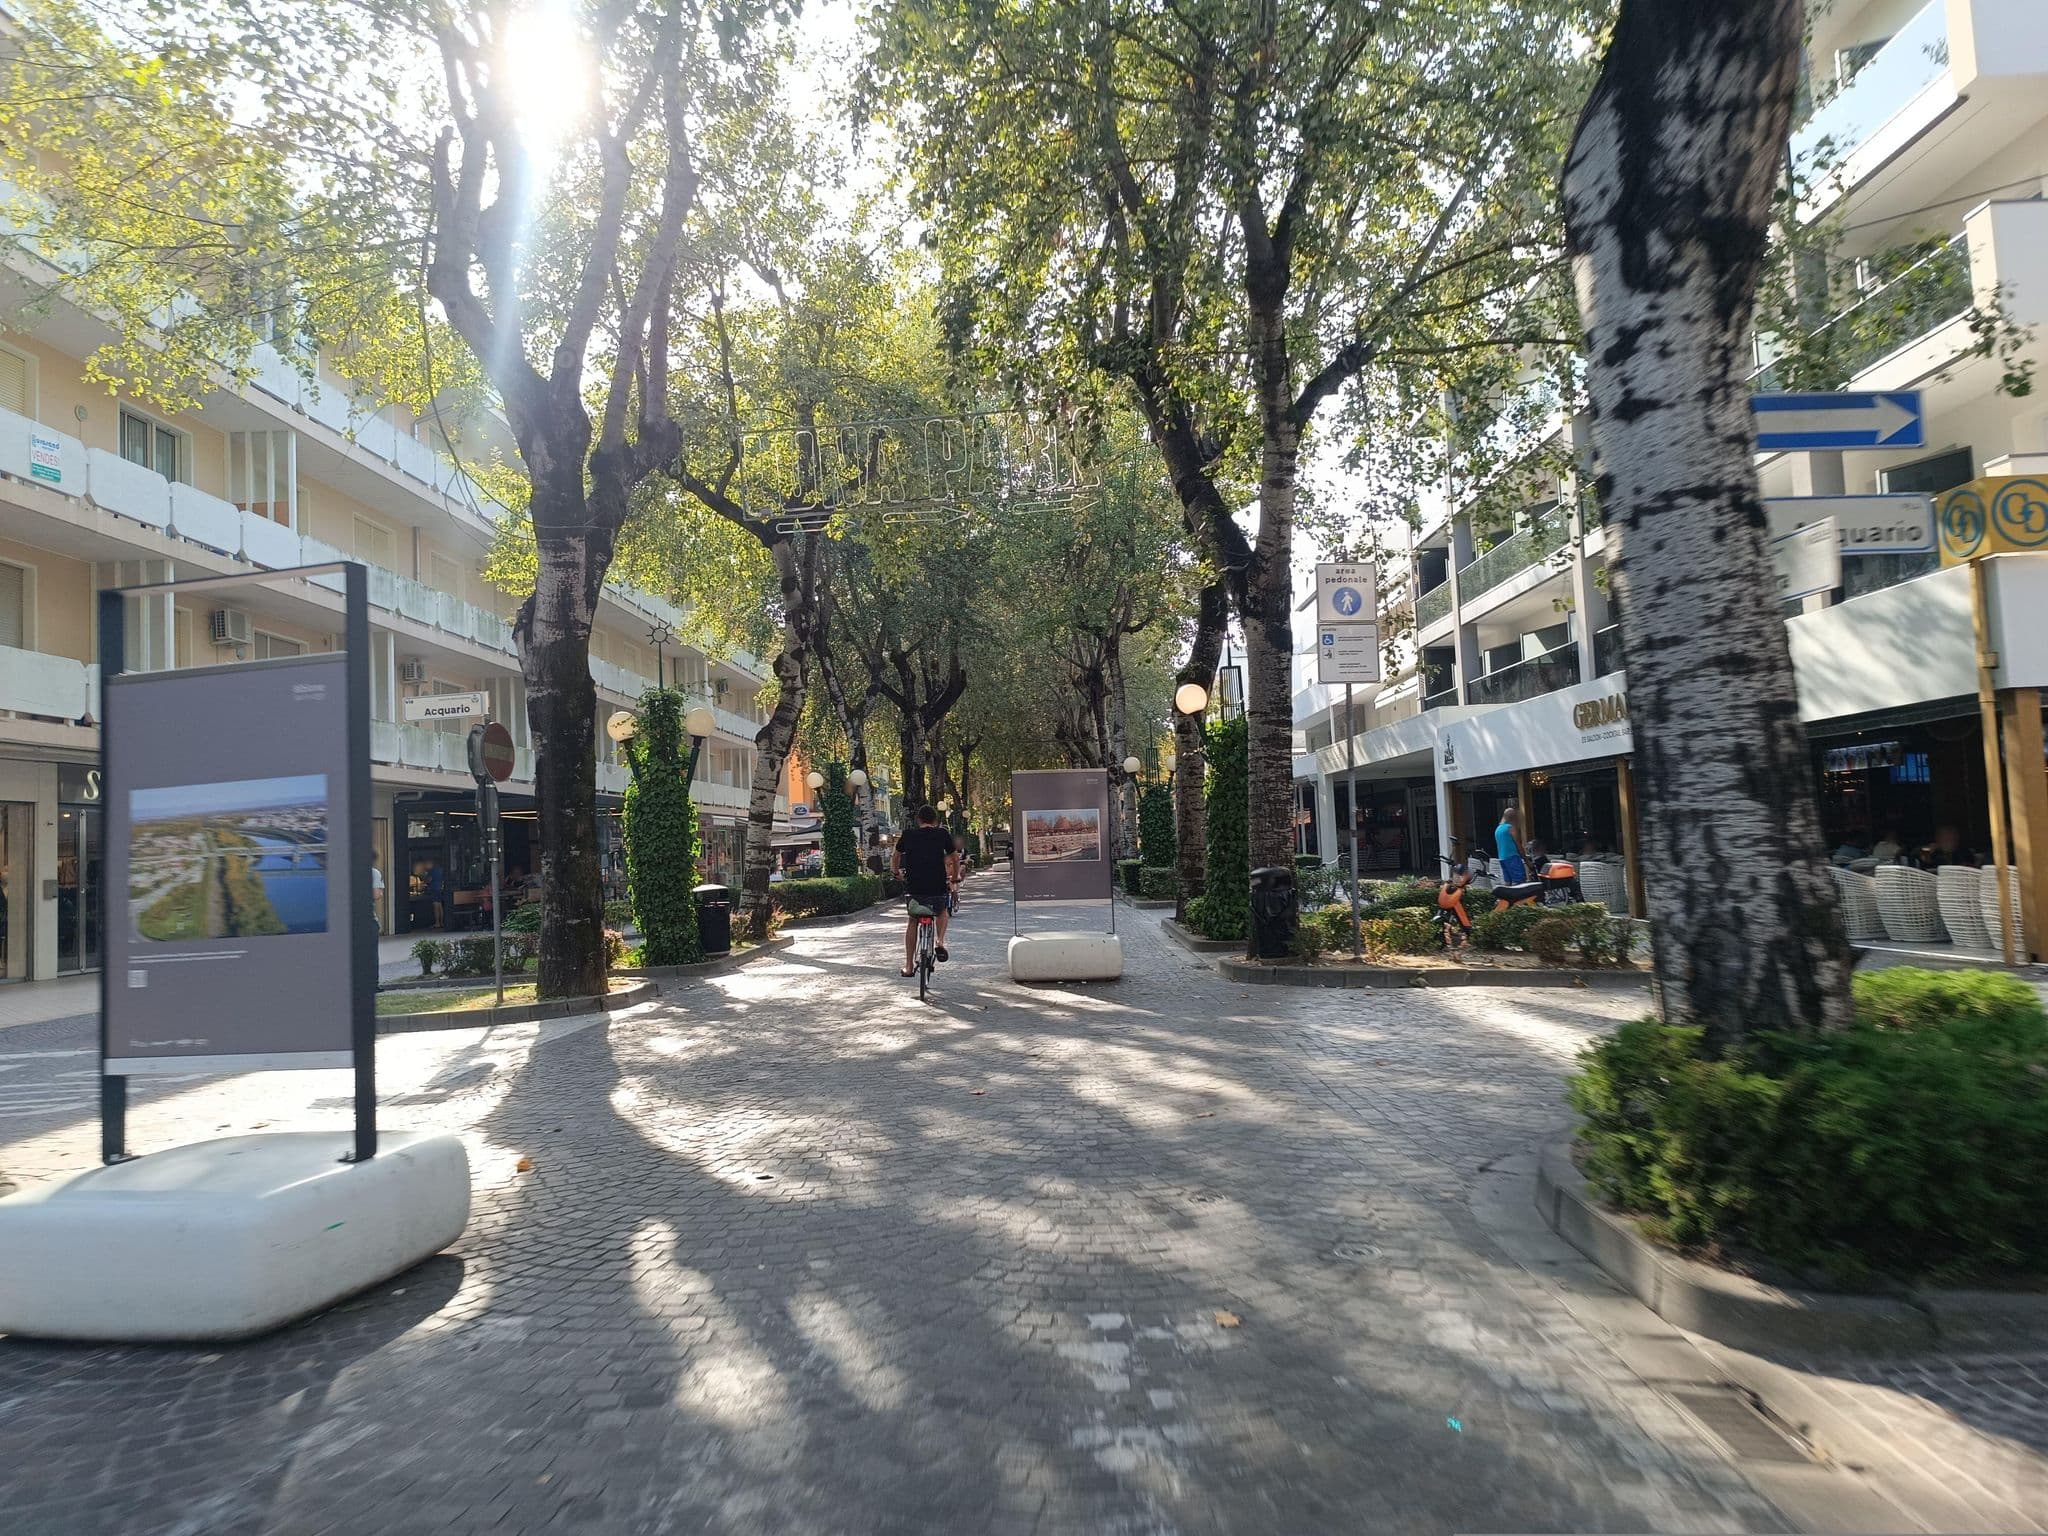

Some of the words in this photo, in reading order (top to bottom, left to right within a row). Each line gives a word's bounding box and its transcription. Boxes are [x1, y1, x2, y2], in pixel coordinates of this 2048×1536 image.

[1335, 567, 1356, 575] area
[1325, 576, 1368, 584] pedonale
[424, 704, 470, 717] Acquario
